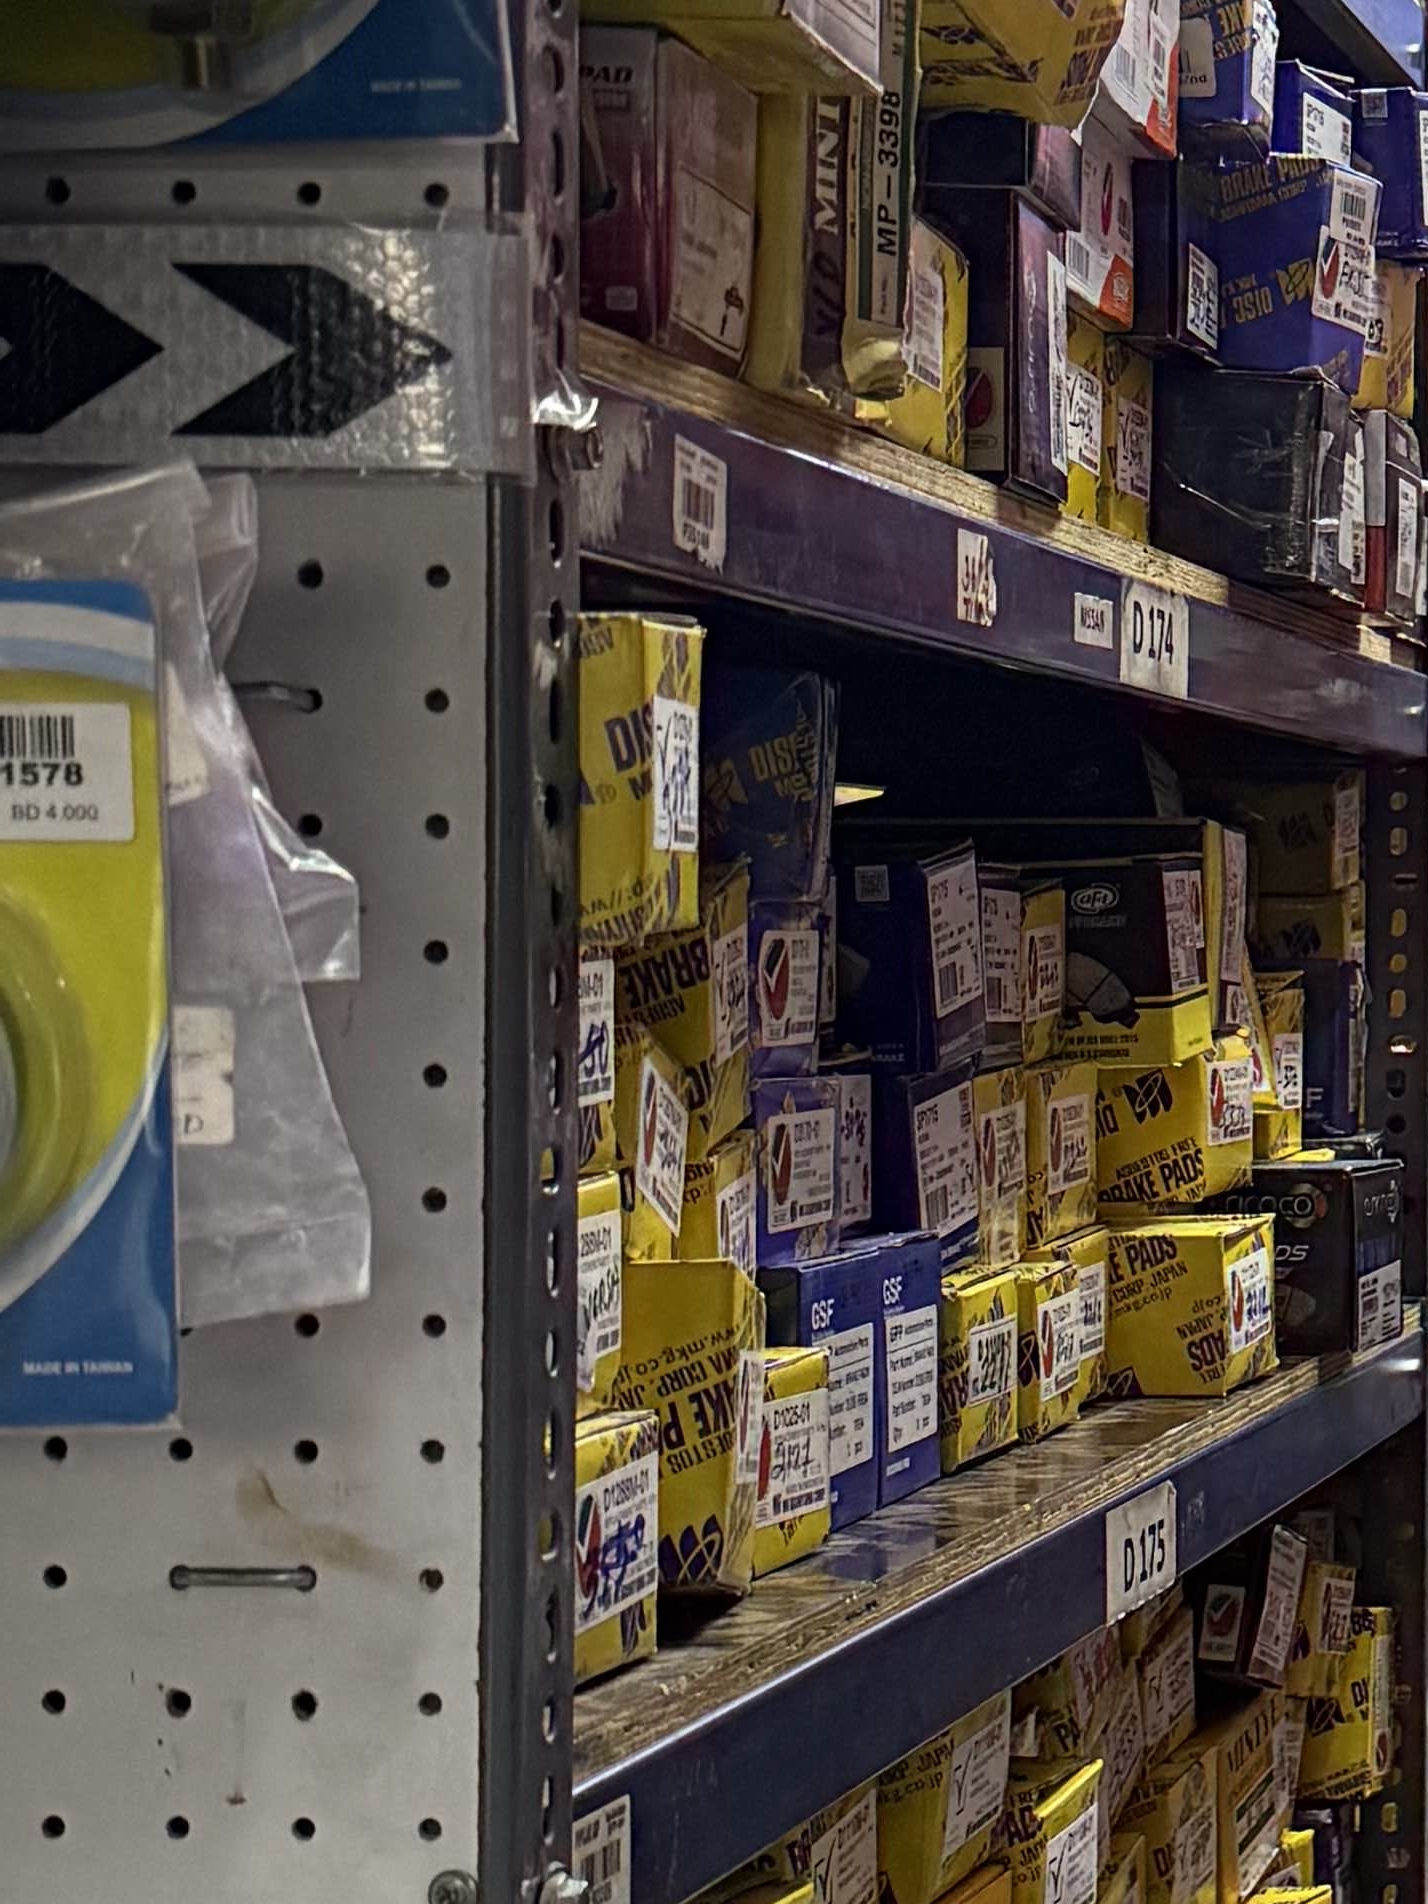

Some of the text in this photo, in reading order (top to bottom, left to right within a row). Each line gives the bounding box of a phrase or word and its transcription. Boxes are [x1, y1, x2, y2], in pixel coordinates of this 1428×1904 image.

[1132, 613, 1175, 667] D 174
[1163, 1149, 1204, 1190] PADS
[1128, 1234, 1177, 1274] PADS
[882, 1276, 902, 1305] GSF
[812, 1299, 835, 1330] GSF
[23, 1362, 61, 1375] MADE
[64, 1362, 79, 1375] IN
[1123, 1522, 1166, 1593] D 175
